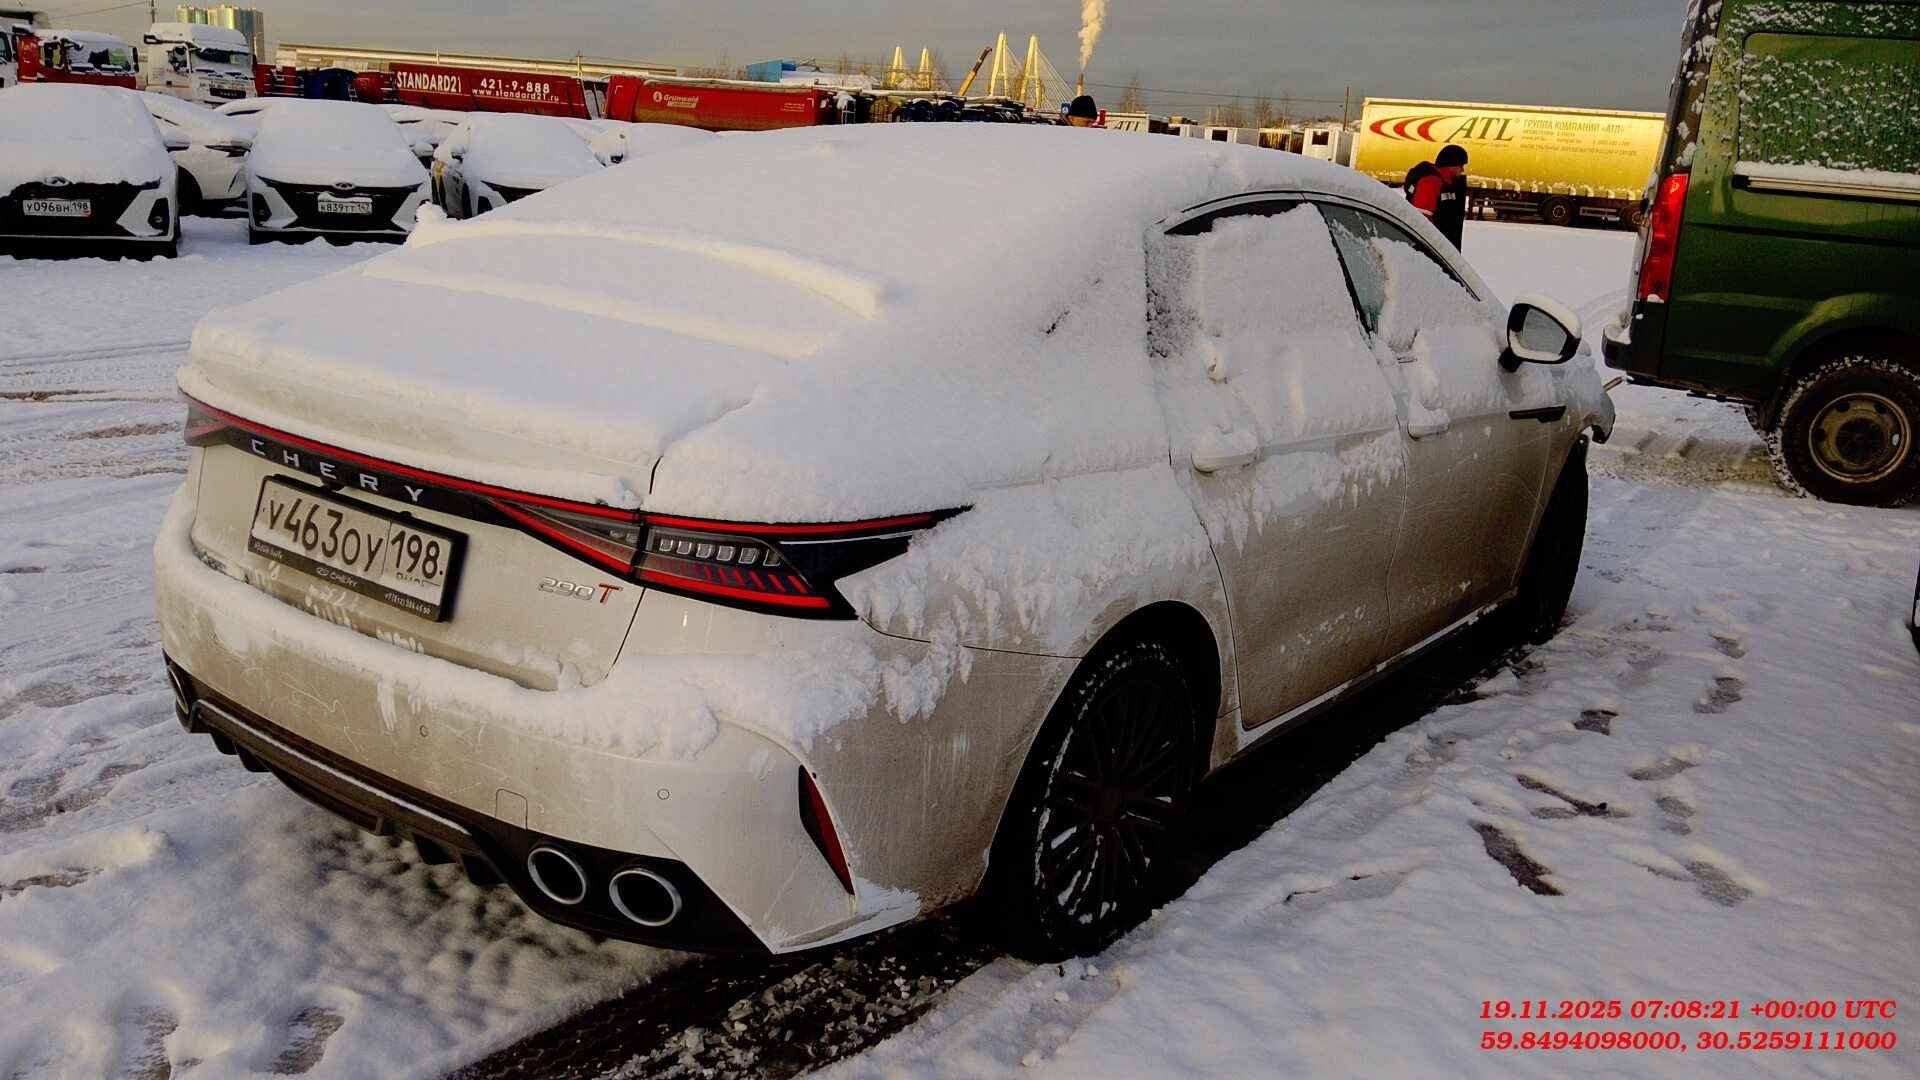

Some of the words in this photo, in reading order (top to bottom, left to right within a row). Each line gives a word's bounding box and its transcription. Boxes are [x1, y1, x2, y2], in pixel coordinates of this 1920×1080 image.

[396, 71, 462, 93] STANDARD21
[480, 77, 550, 94] 421-9-888
[1444, 115, 1516, 143] ATL
[251, 439, 424, 502] CHERY
